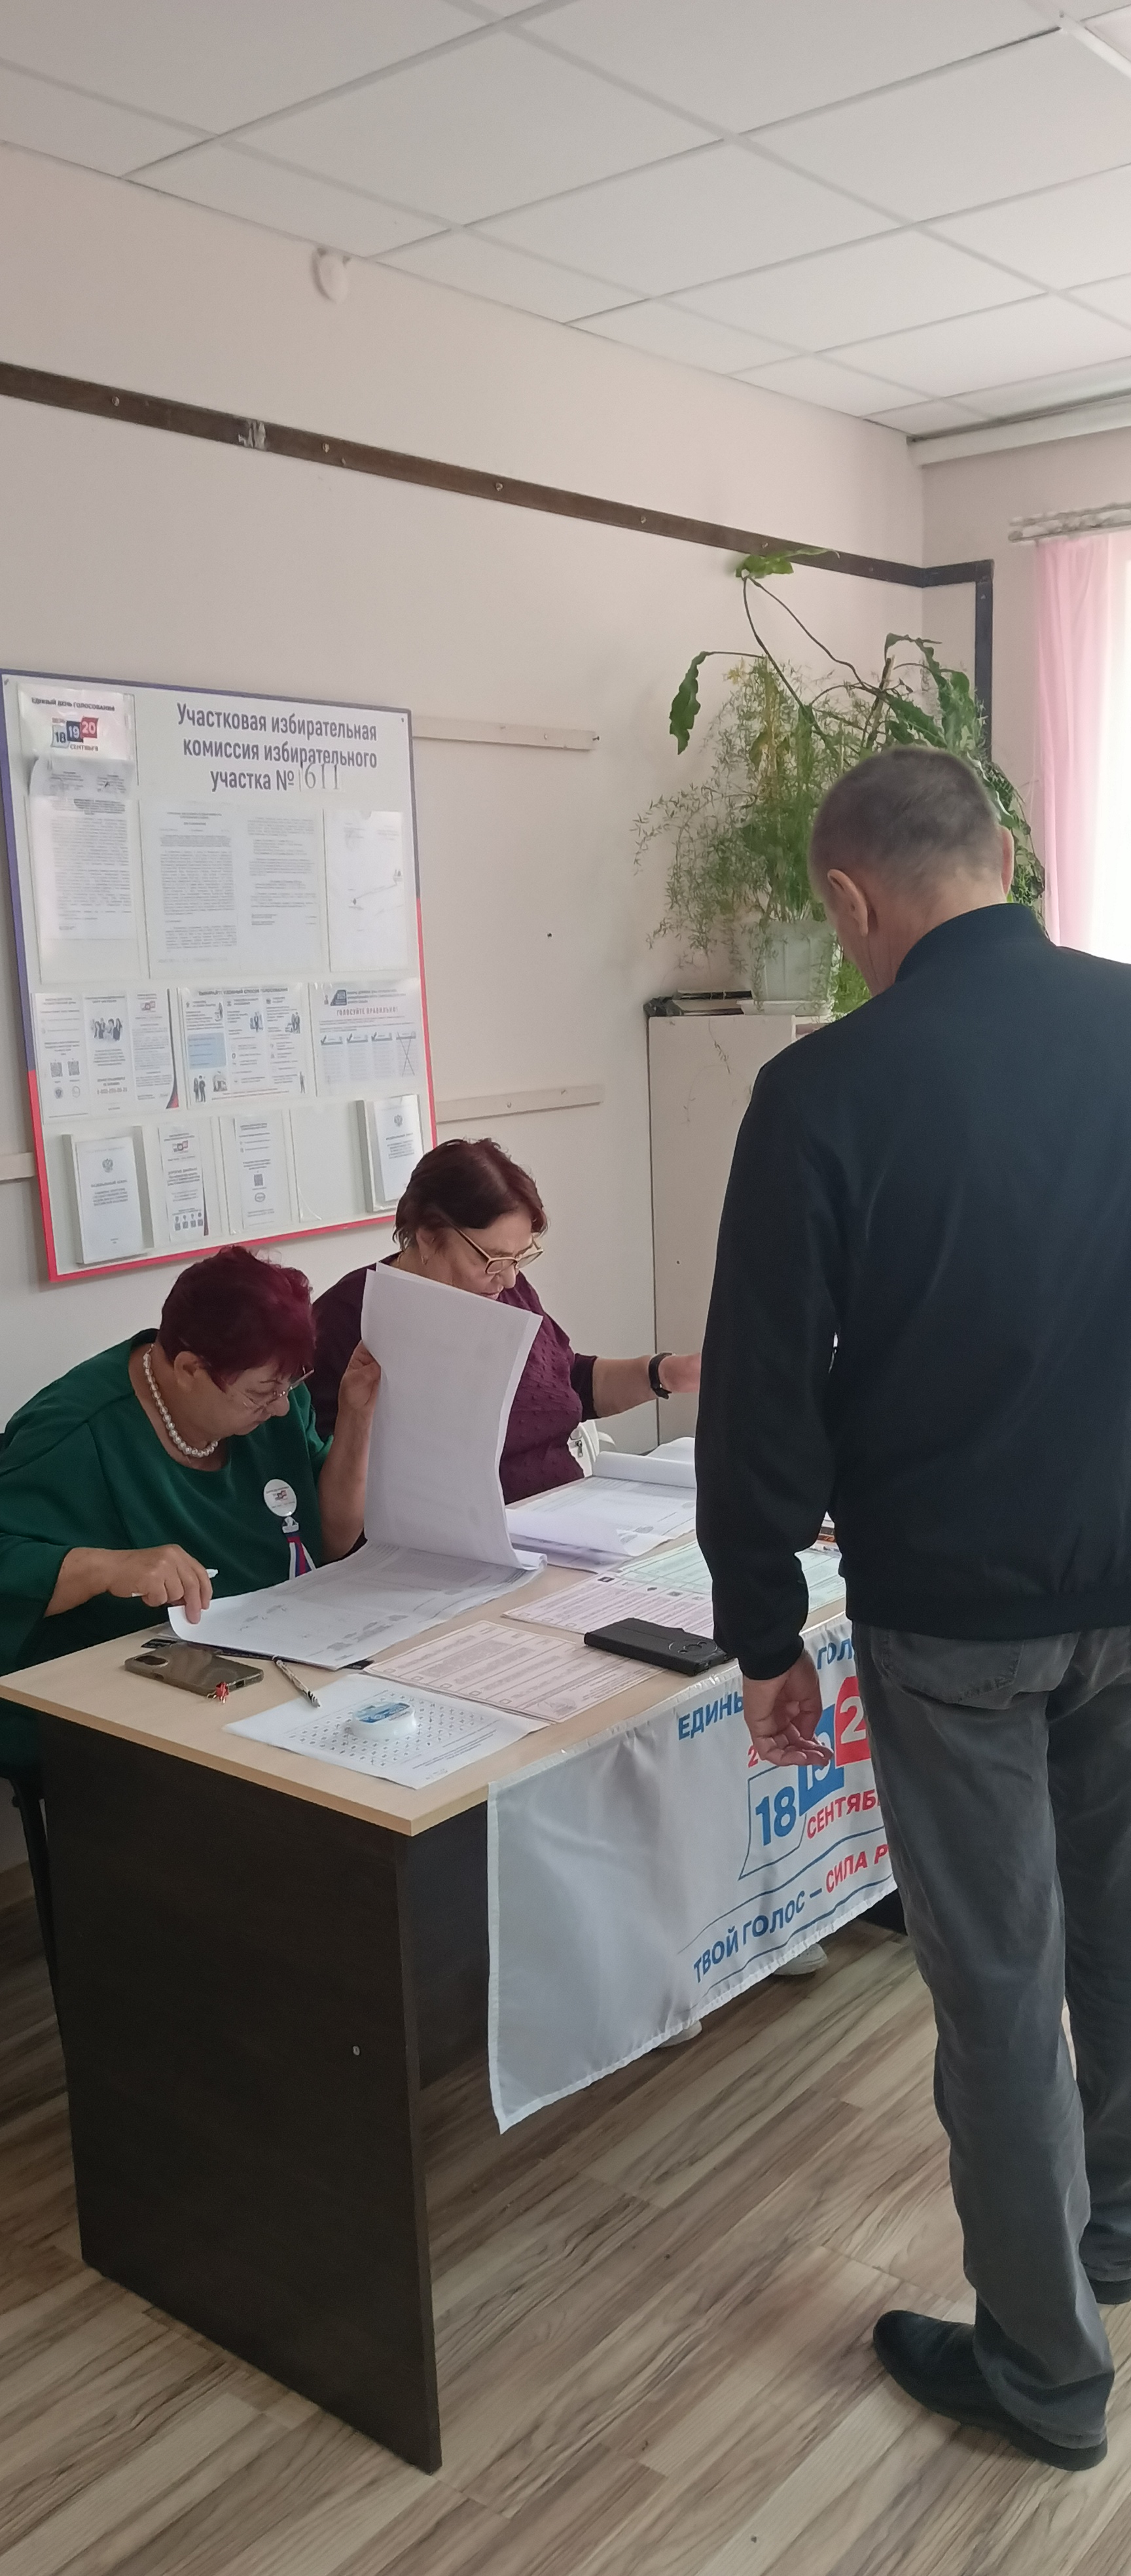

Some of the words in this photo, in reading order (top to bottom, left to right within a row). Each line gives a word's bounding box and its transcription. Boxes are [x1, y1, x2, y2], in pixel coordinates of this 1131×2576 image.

[56, 732, 66, 743] 18
[69, 726, 79, 739] 19
[82, 721, 96, 734] 20
[177, 702, 266, 732] Участковая
[271, 713, 377, 741] избирательная
[183, 738, 259, 760] комиссия
[264, 741, 377, 768] избирательного
[210, 770, 271, 792] участка
[817, 1638, 852, 1670] ГОЛ
[756, 1785, 797, 1846] 18
[840, 1696, 866, 1744] 2
[807, 1789, 880, 1839] СЕНТЯБ
[693, 1926, 739, 1983] ТВОЙ
[743, 1891, 805, 1945] ГОЛОС
[825, 1851, 868, 1893] СИЛА
[874, 1844, 889, 1865] Р
